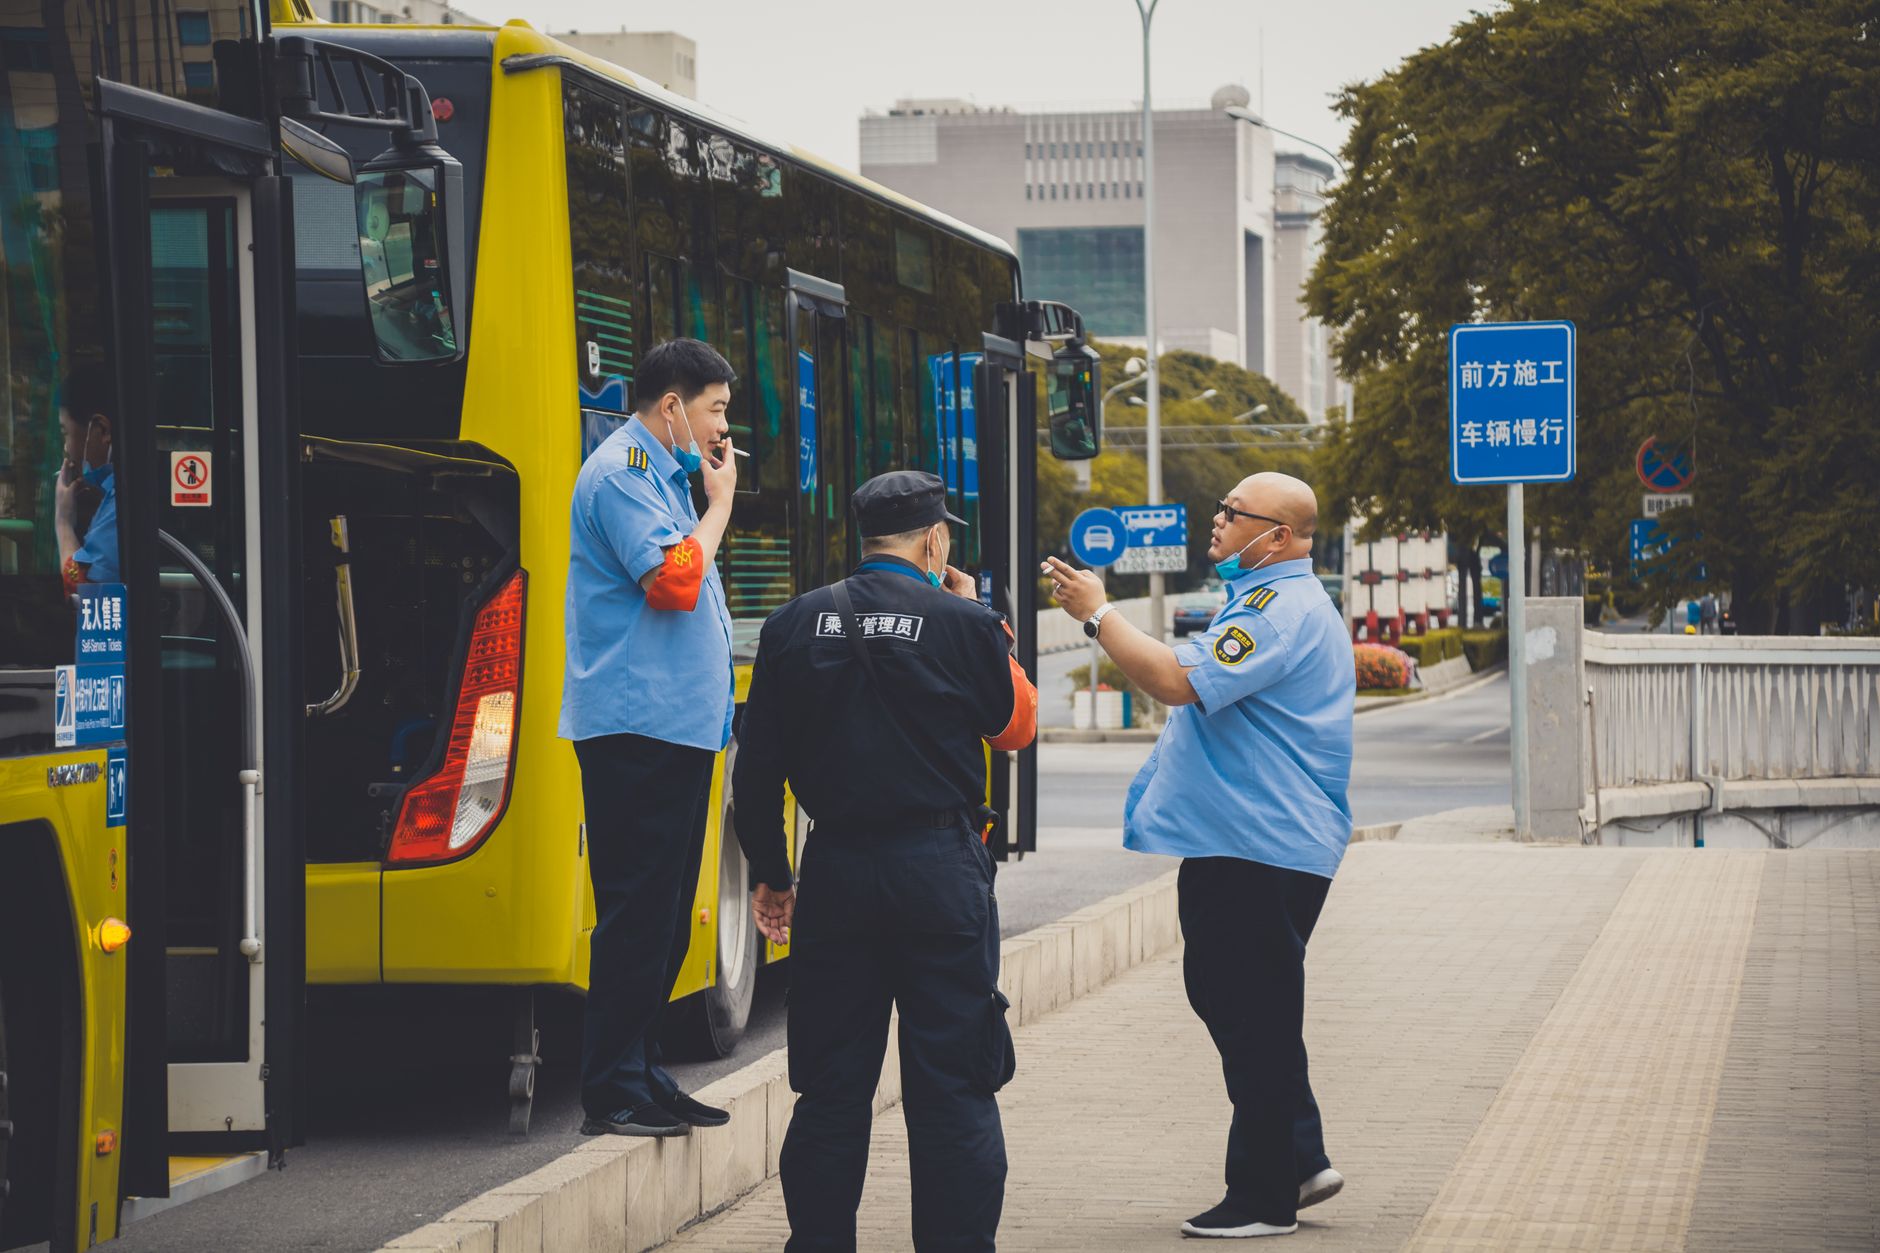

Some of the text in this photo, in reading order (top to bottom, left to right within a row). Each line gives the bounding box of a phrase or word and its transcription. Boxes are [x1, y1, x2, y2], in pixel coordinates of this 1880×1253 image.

[1460, 360, 1564, 388] 前方施工
[1460, 418, 1564, 447] 车辆慢行
[81, 596, 122, 631] 无人售票
[823, 615, 913, 636] 乘管理员
[81, 638, 122, 652] Self-Service Tickets
